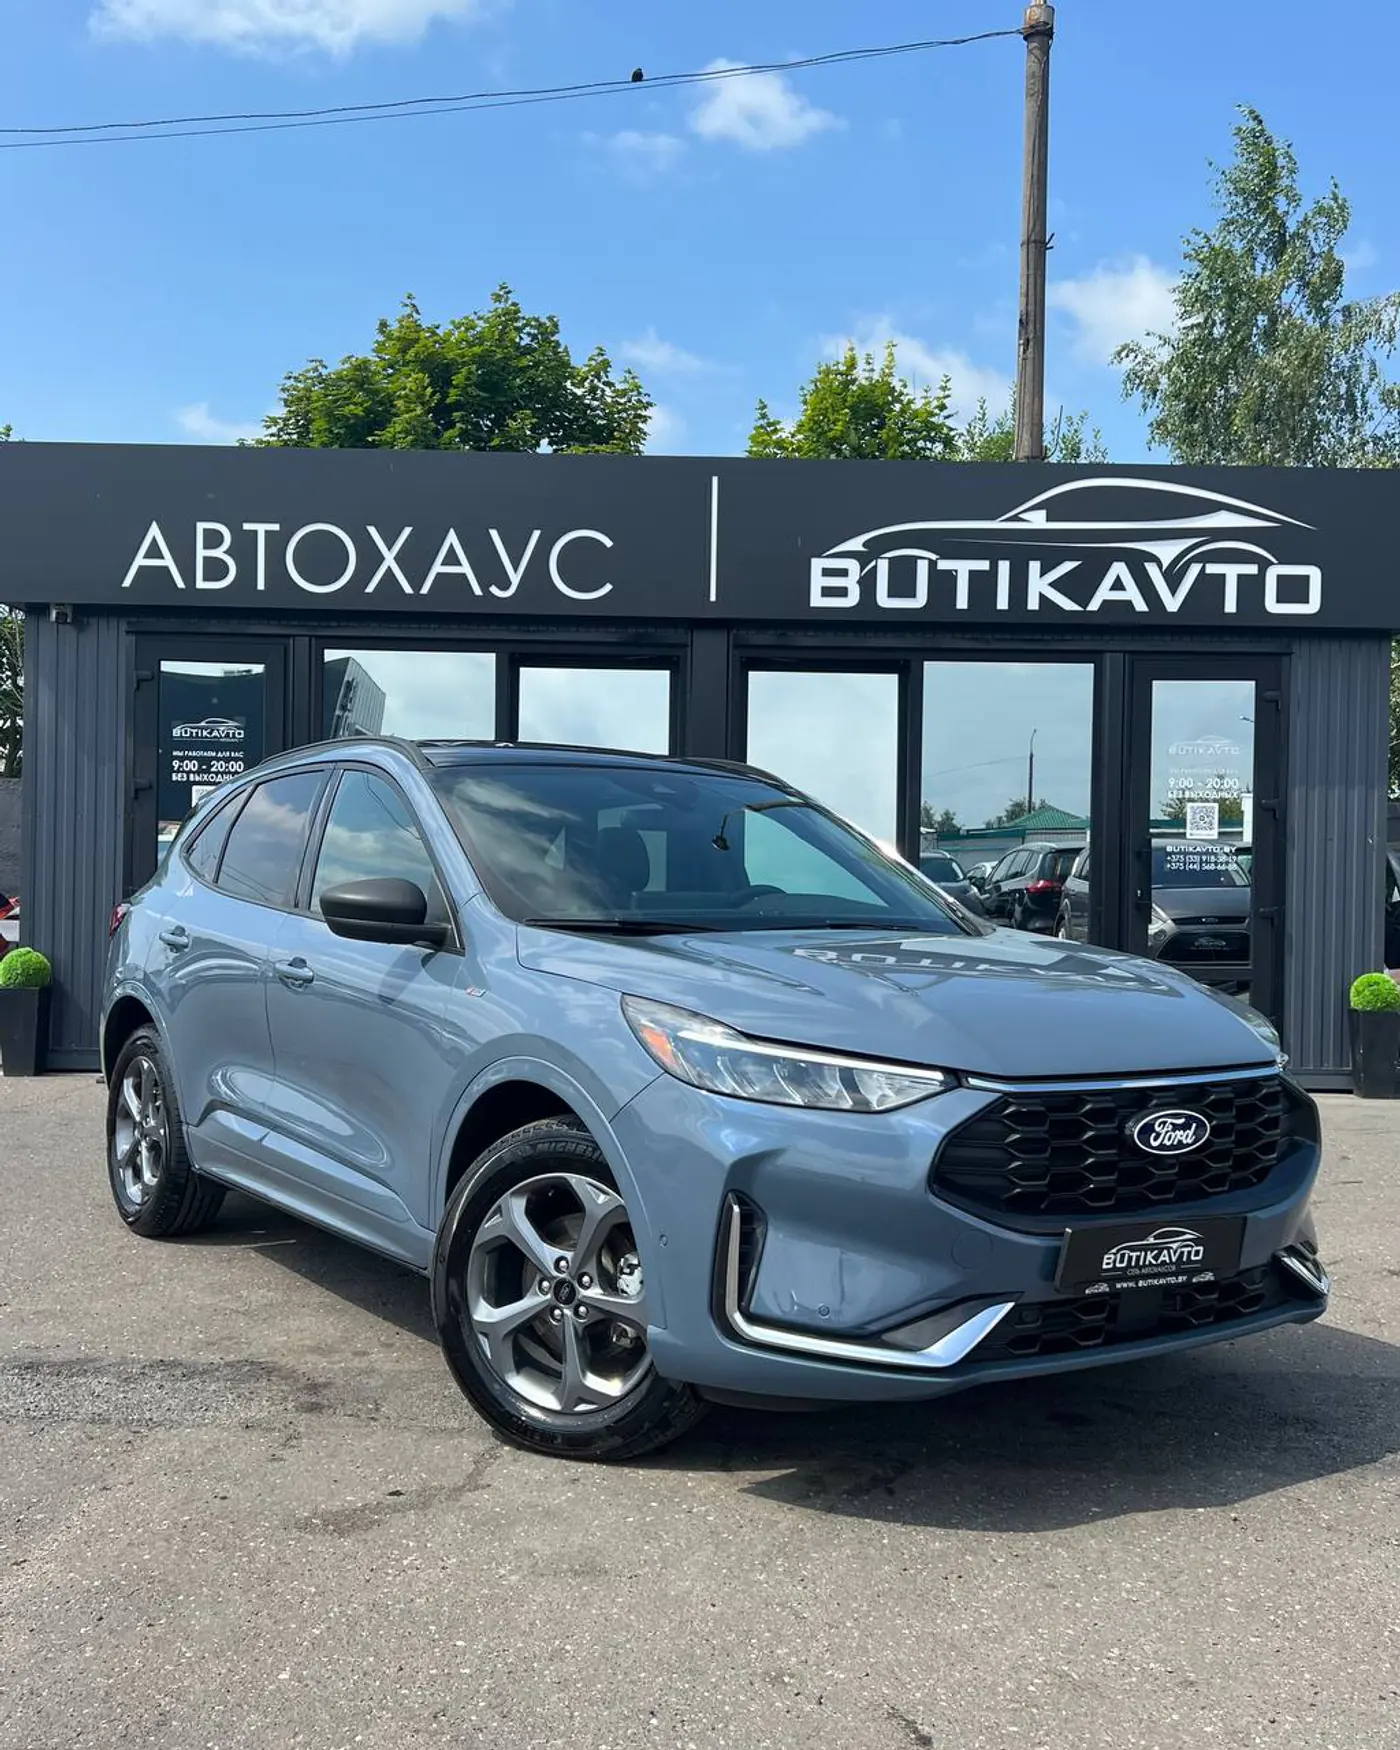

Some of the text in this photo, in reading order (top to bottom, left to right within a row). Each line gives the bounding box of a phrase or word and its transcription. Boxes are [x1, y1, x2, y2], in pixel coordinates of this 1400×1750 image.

[121, 519, 615, 600] АВТОХАУС
[809, 556, 1323, 615] BUTIKAVTO
[172, 728, 245, 738] BUTIKAVTO
[172, 760, 198, 771] 9:00
[210, 760, 244, 772] 20:00
[172, 773, 187, 781] БЕЗ
[1168, 777, 1194, 788] 9:00
[1205, 778, 1239, 789] 20:00
[1166, 845, 1237, 853] BUTIKAVTO.BY
[1166, 854, 1184, 862] +375
[1166, 862, 1184, 870] +375
[1150, 1117, 1197, 1147] Ford
[1102, 1245, 1204, 1269] BUTIKAVTO
